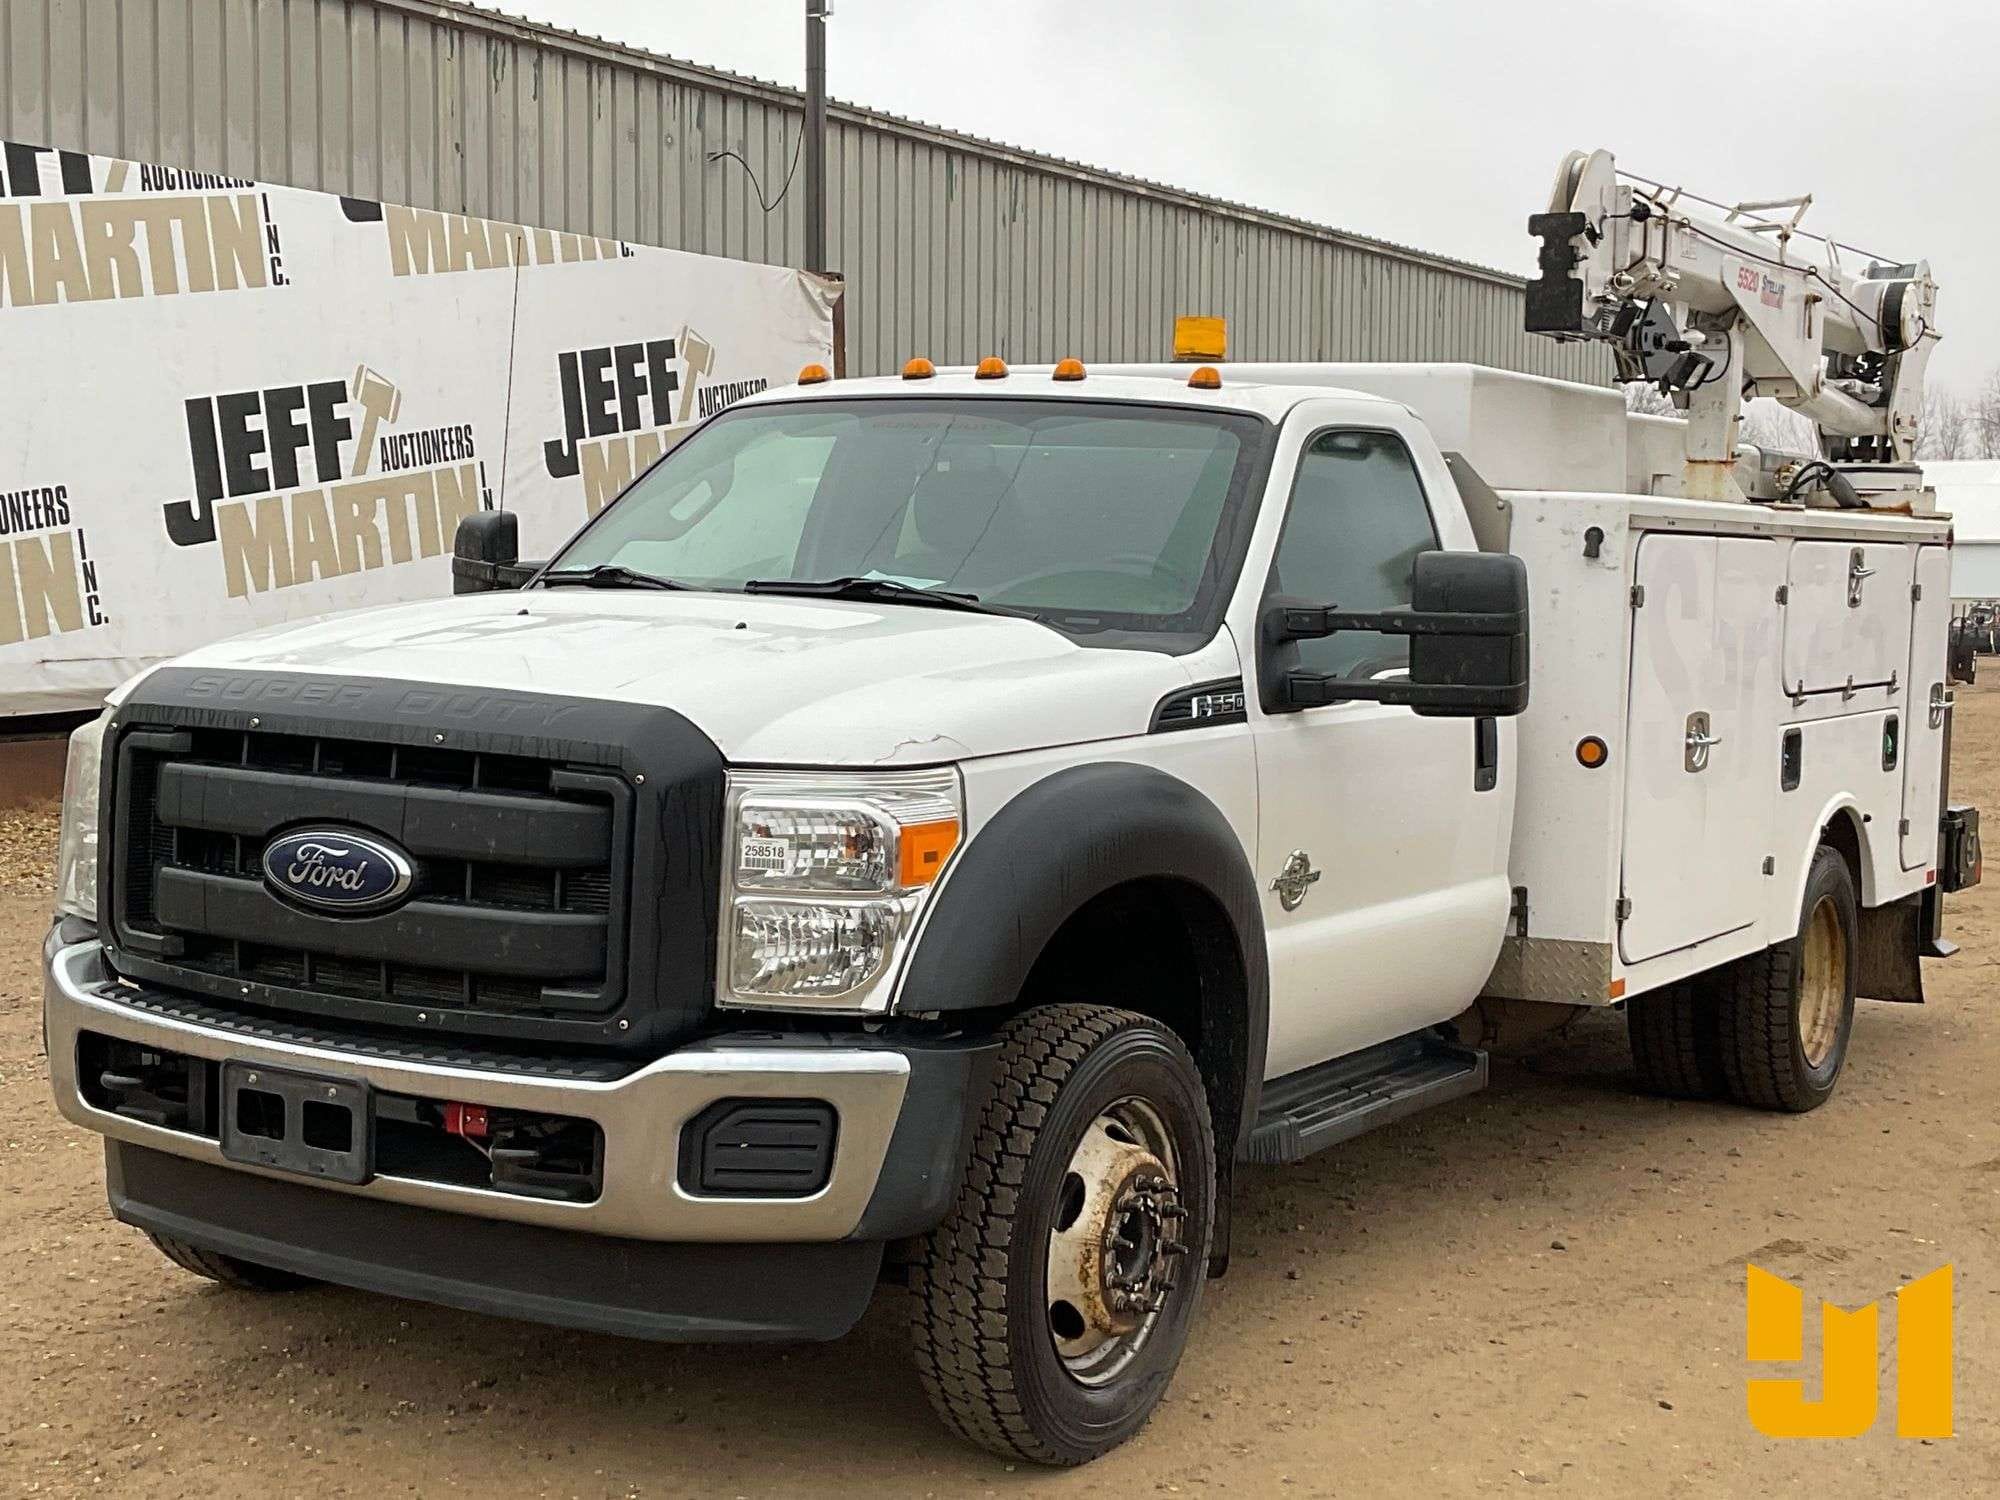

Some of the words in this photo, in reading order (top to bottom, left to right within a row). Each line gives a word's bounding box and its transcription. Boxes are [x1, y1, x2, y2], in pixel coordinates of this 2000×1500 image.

[544, 339, 679, 478] JEFF
[164, 380, 352, 546] JEFF
[380, 424, 475, 472] AUCTIONEERS
[217, 464, 478, 598] MARTIN
[184, 675, 377, 708] SUPER
[398, 687, 585, 727] DUTY
[289, 843, 367, 891] Ford
[745, 845, 784, 858] 258518
